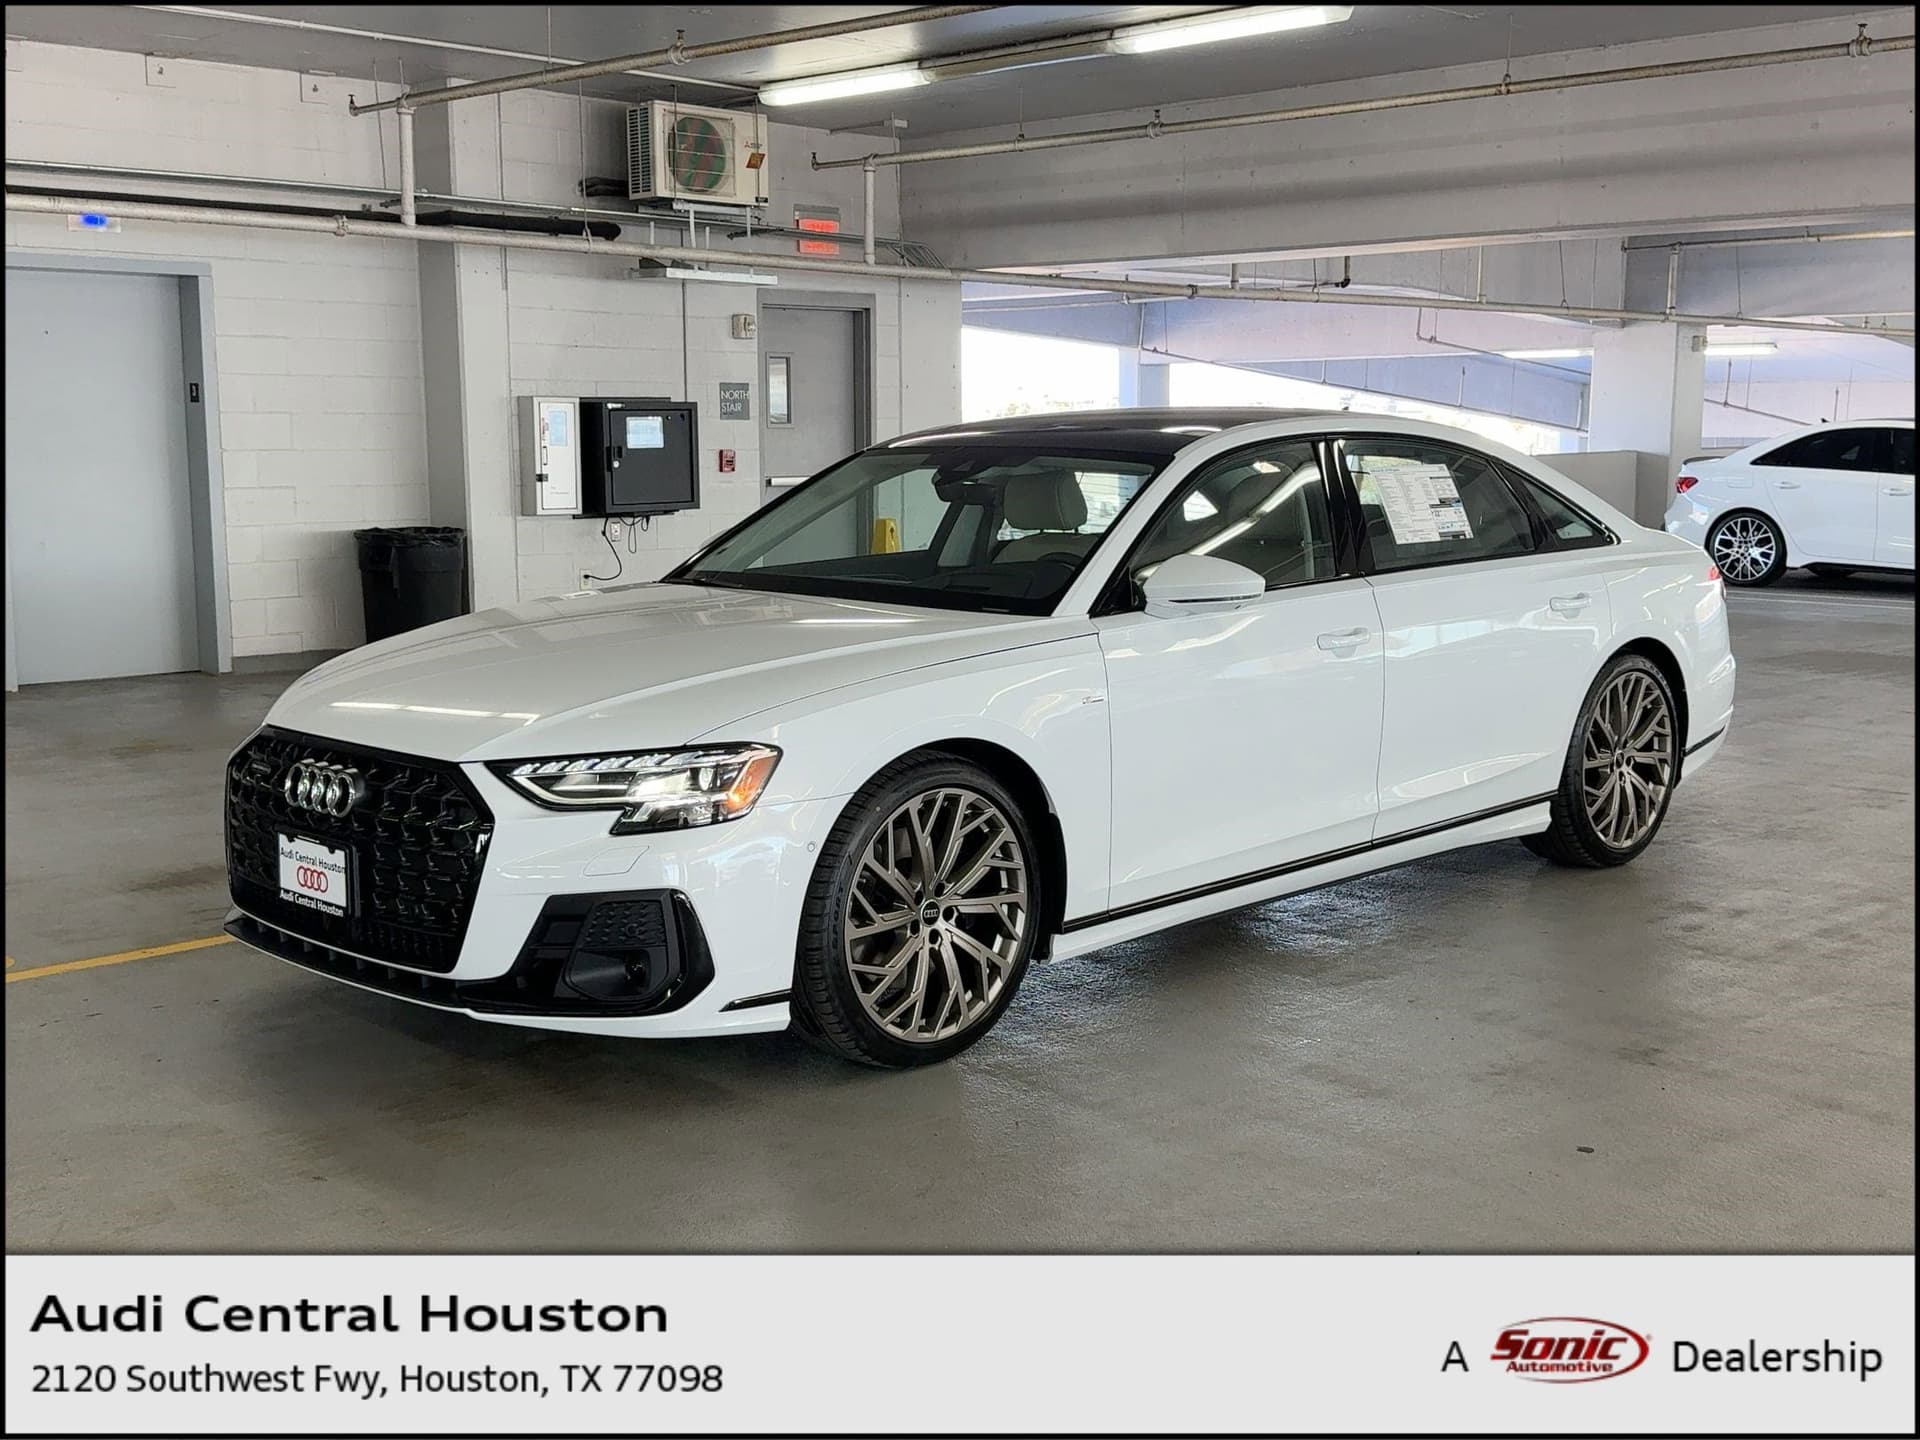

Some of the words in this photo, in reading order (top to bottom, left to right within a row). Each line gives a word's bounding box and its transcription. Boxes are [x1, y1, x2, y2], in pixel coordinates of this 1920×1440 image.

[720, 390, 750, 400] NORTH
[721, 402, 742, 412] STAIR
[281, 847, 294, 859] Audi
[295, 852, 317, 865] Central
[319, 857, 345, 873] Houston
[280, 889, 294, 902] Audi
[295, 894, 317, 909] Central
[317, 901, 344, 917] Houston
